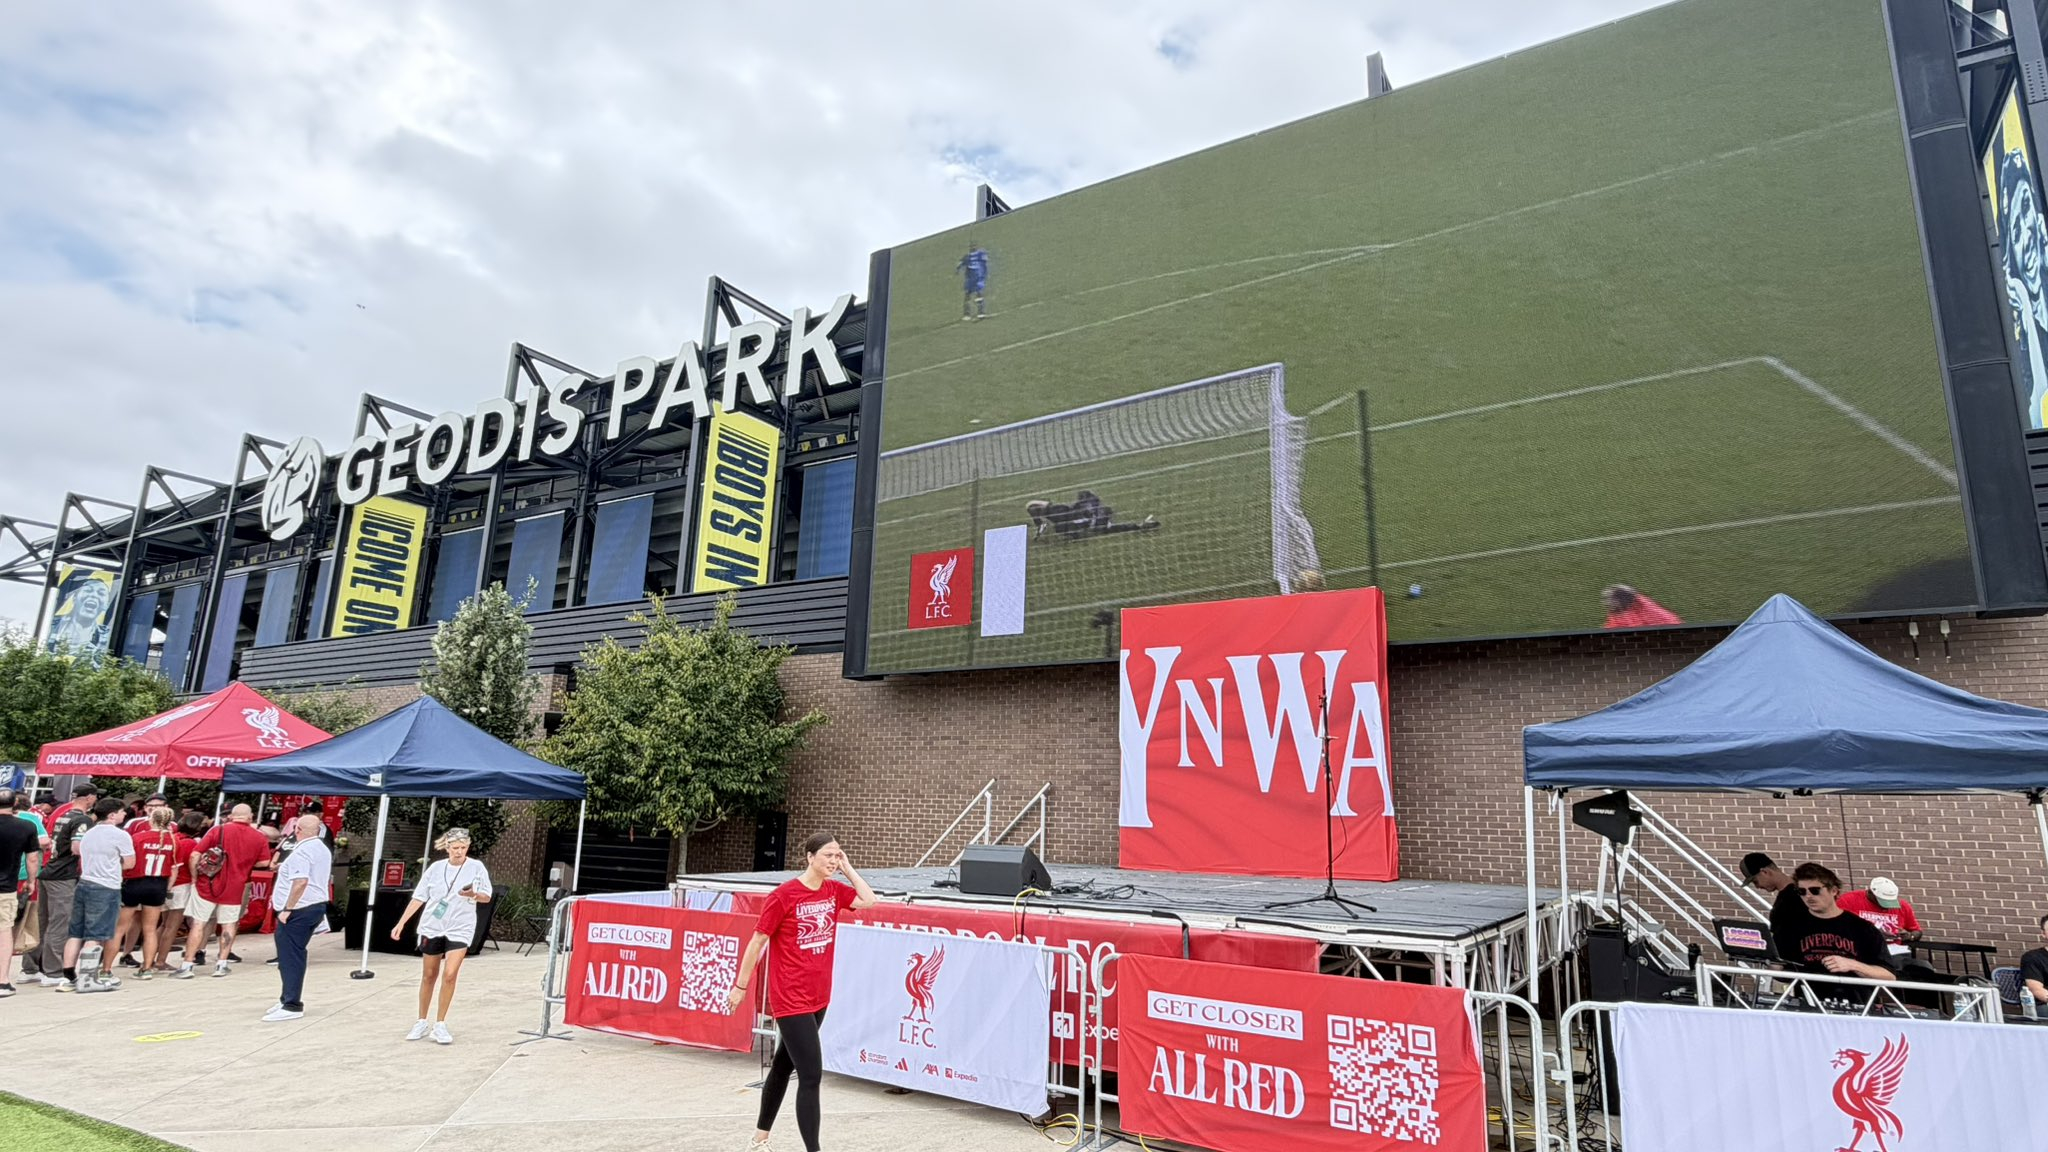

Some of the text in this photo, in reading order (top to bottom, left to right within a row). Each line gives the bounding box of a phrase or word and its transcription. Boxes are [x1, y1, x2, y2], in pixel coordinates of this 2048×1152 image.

[337, 293, 856, 505] GEODIS PARK
[705, 440, 769, 588] BOYS IN
[342, 520, 412, 634] COME ON
[1119, 646, 1394, 828] YNWA
[46, 754, 158, 765] OFFICIAL LICENSED PRODUCT
[186, 755, 249, 767] OFFIC
[145, 853, 165, 877] 11
[591, 927, 667, 945] GET CLOSER
[1800, 933, 1857, 957] LIVERPOOL
[582, 962, 668, 1004] ALL RED
[1153, 998, 1297, 1034] GET CLOSER
[899, 1023, 937, 1048] L.F.C.
[1206, 1033, 1239, 1053] WITH
[922, 1063, 939, 1076] AXA
[1148, 1046, 1305, 1119] ALL RED
